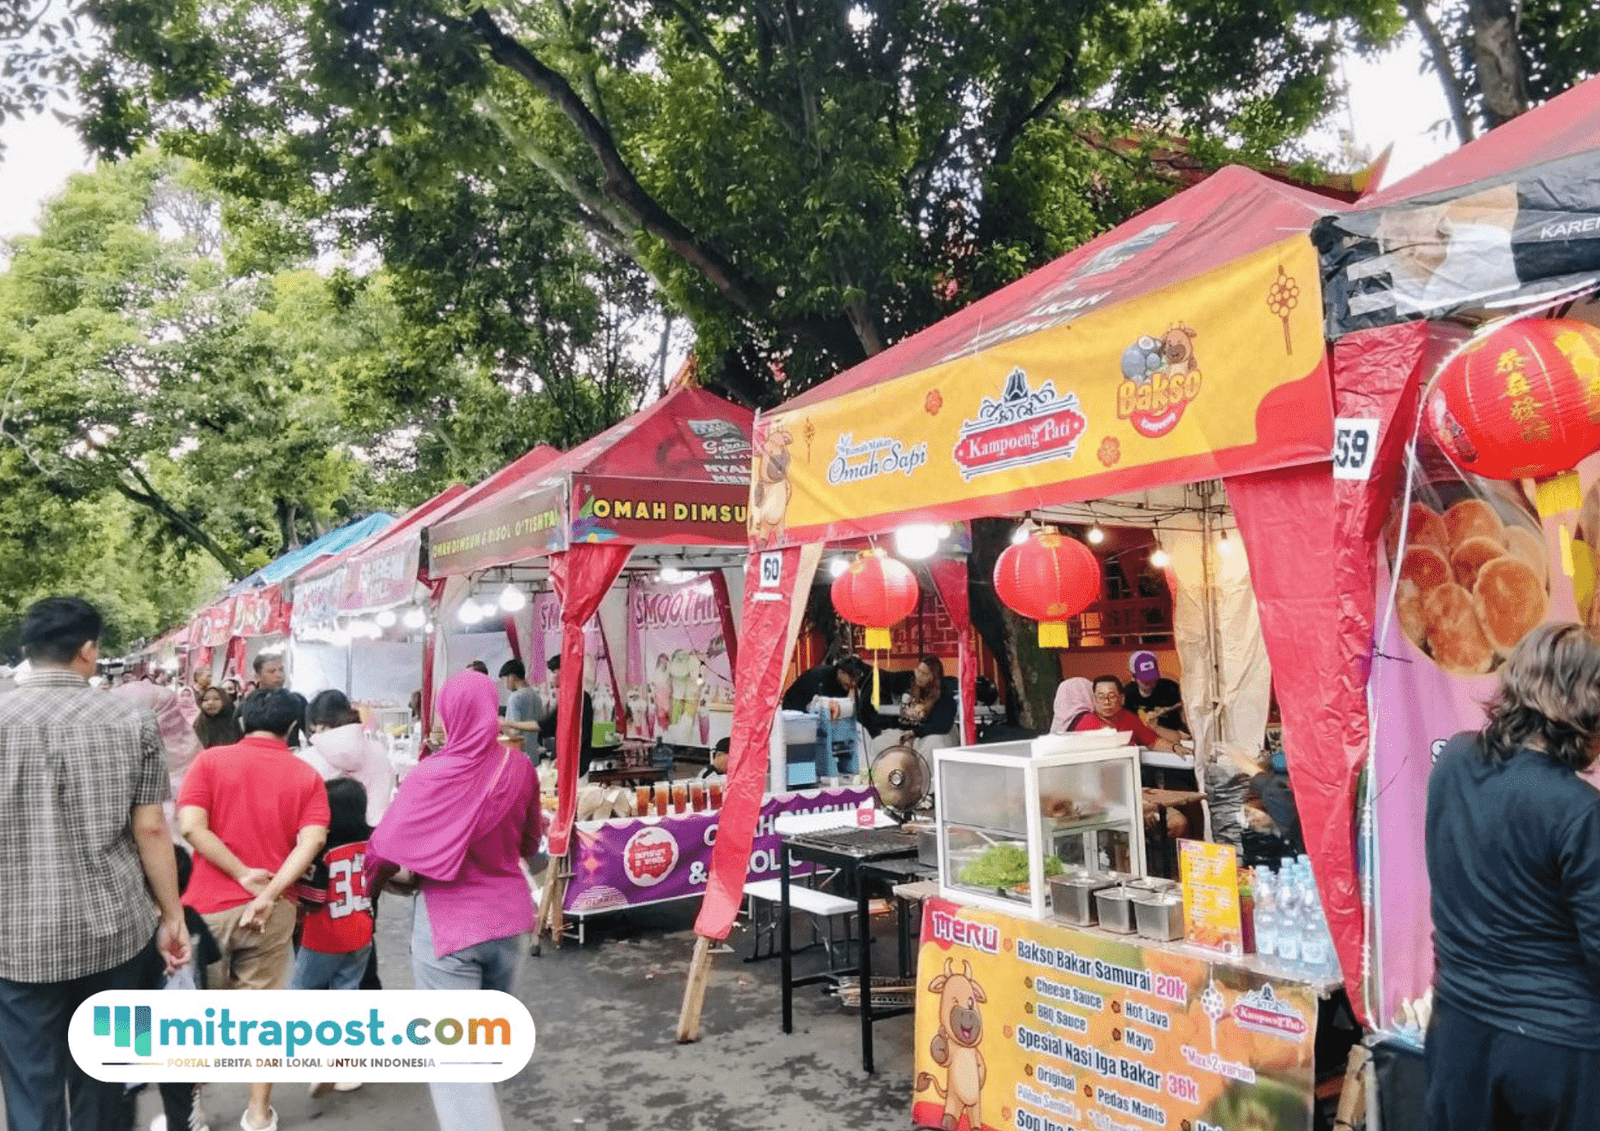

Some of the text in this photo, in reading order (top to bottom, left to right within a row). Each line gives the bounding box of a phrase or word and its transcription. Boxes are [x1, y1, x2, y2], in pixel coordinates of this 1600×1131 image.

[1117, 371, 1201, 420] Bakso
[969, 419, 1061, 461] Kampoeng Pati
[1335, 429, 1369, 468] 59
[829, 442, 926, 483] Omah Sapi
[593, 499, 748, 522] OMAH DIMSU
[763, 557, 780, 580] 60
[1017, 940, 1054, 966] Bakso
[1057, 950, 1092, 976] Bakar
[1095, 961, 1151, 991] Samurai
[1036, 978, 1102, 1009] Cheese Sauce
[1037, 1004, 1087, 1031] BBQ Sauce
[1125, 1002, 1169, 1028] Hot Lava
[1125, 1029, 1154, 1051] Mayo
[1018, 1027, 1062, 1056] Spesial
[1065, 1042, 1092, 1067] Nasi
[1096, 1052, 1116, 1076] Iga
[1120, 1059, 1161, 1089] Bakar
[1037, 1066, 1075, 1091] Original
[1098, 1088, 1129, 1112] Pedas
[1132, 1100, 1164, 1124] Manis
